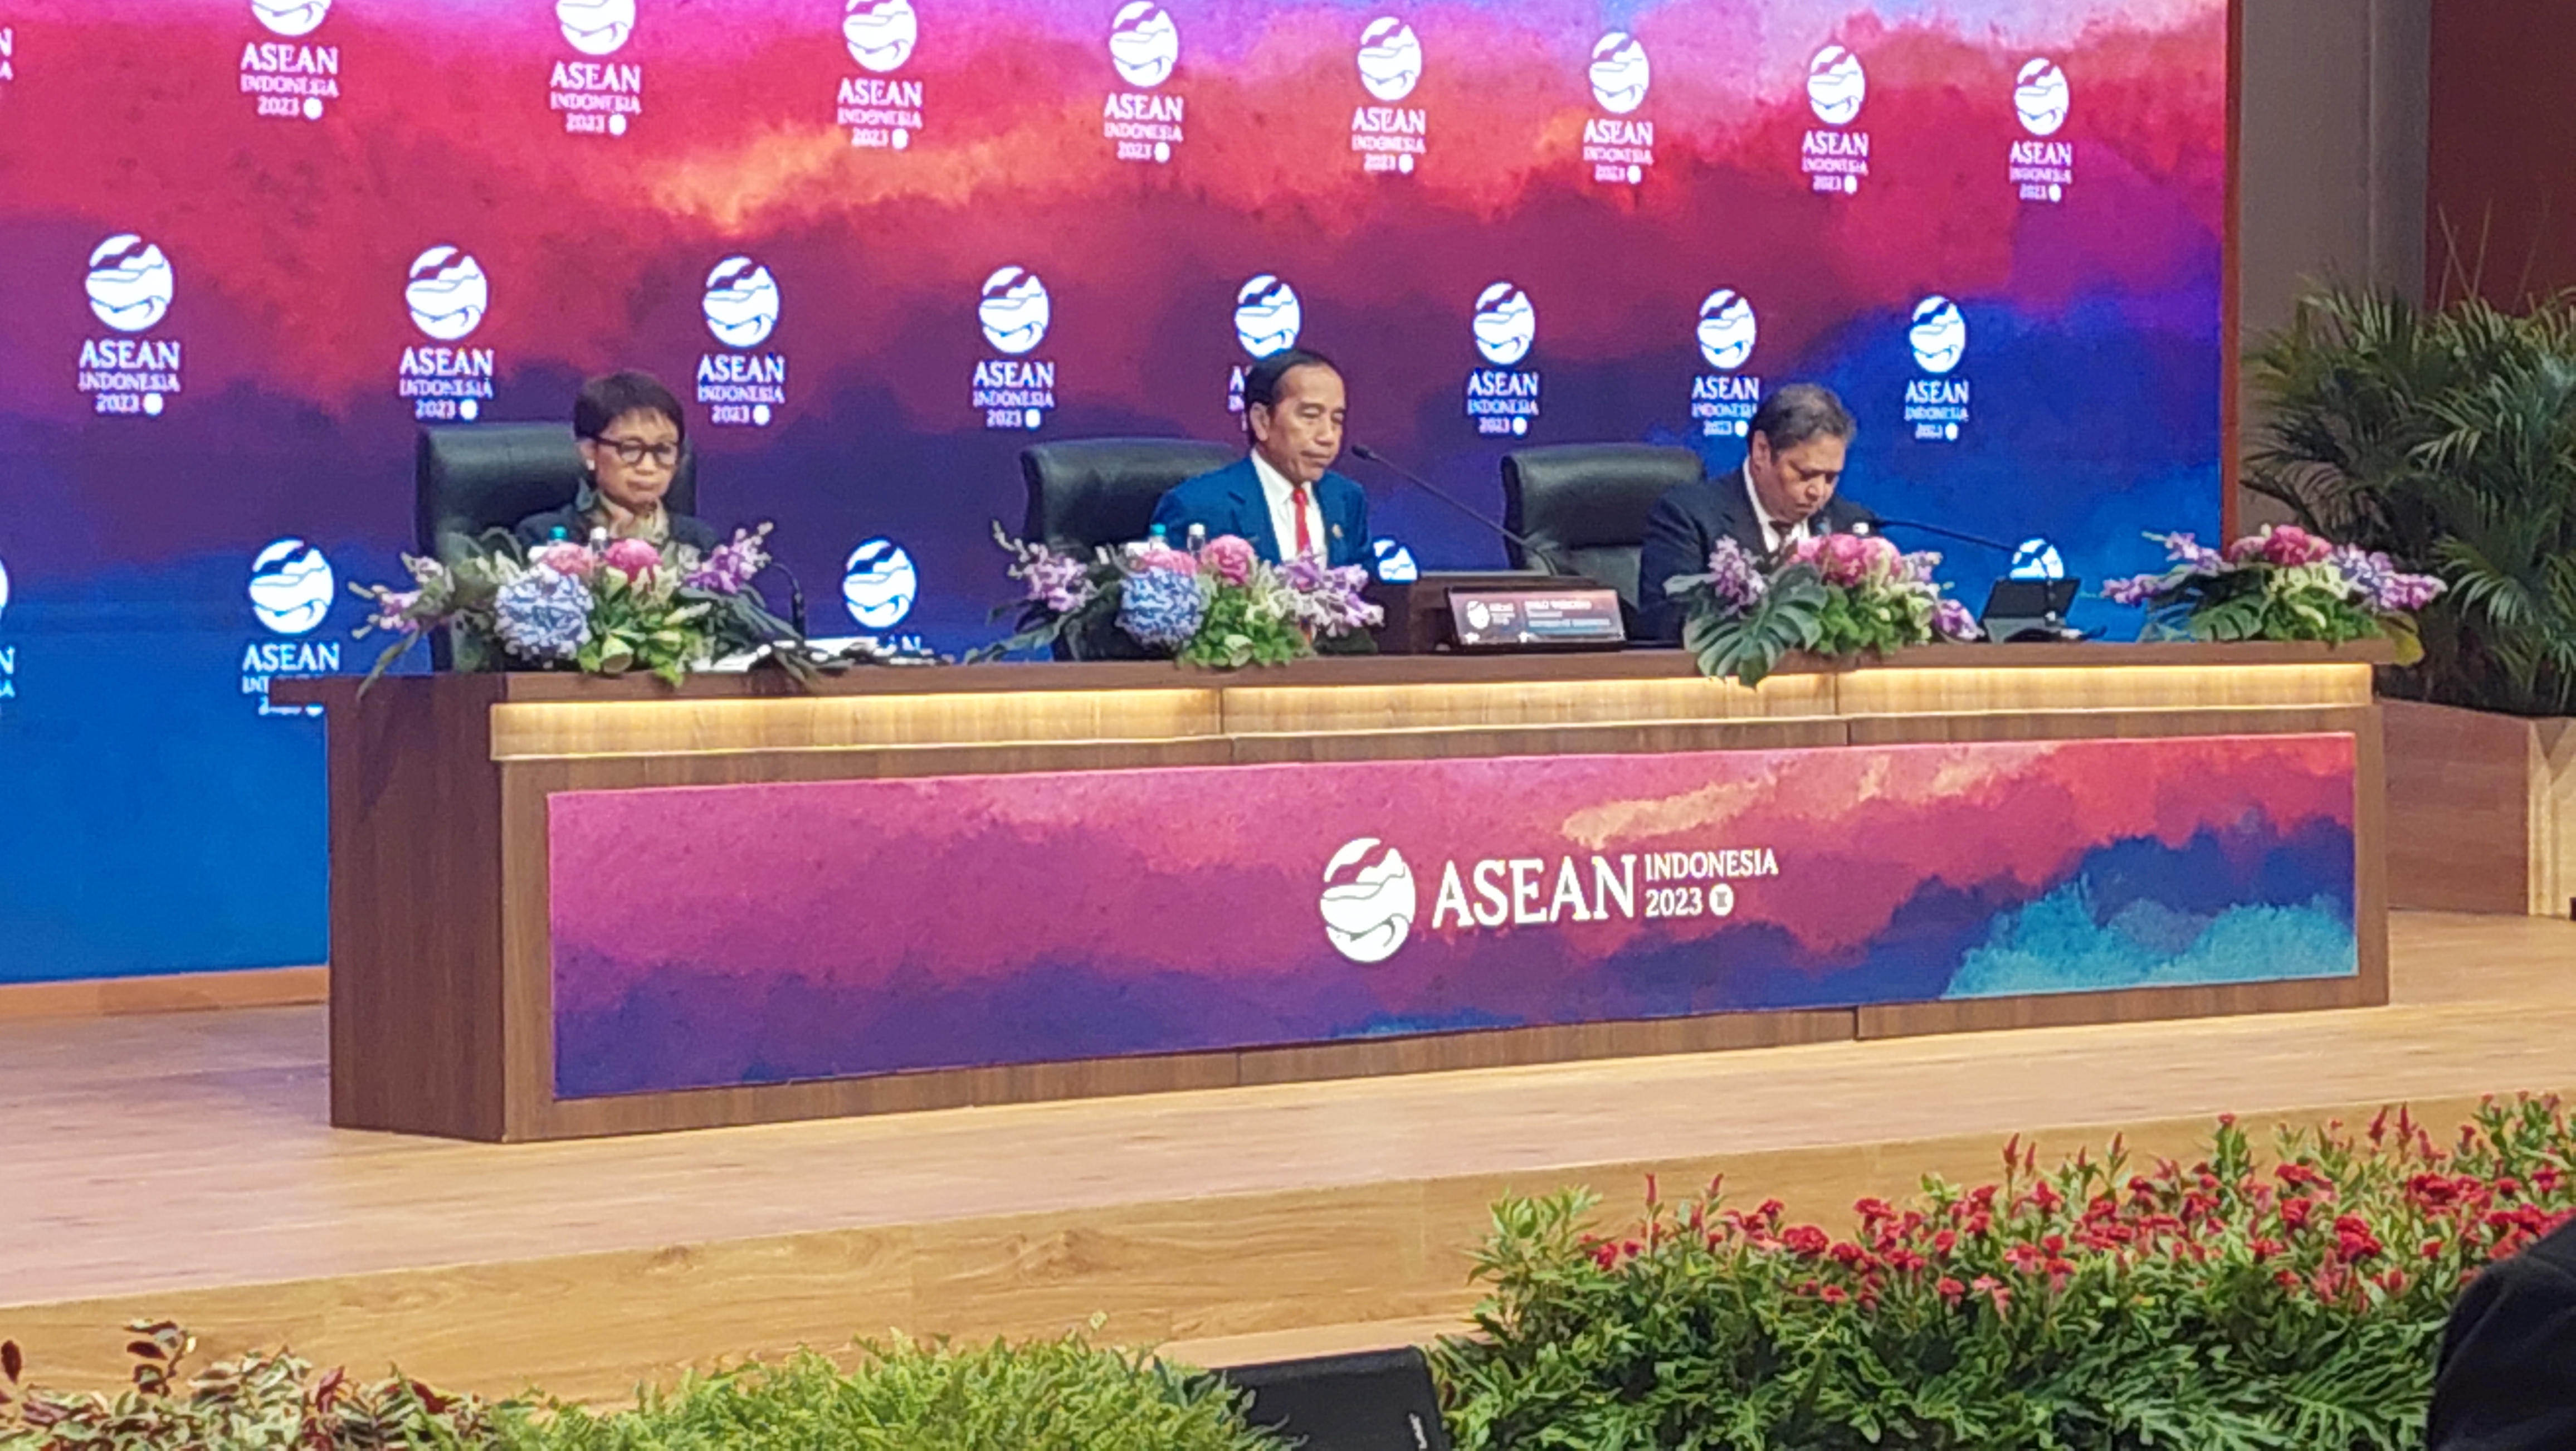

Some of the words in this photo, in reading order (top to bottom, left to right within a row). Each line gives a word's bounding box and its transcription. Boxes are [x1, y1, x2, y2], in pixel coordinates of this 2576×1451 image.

[241, 42, 338, 75] ASEAN
[549, 60, 641, 94] ASEAN
[837, 77, 923, 108] ASEAN
[1104, 92, 1184, 121] ASEAN
[1352, 106, 1426, 135] ASEAN
[1583, 118, 1653, 146] ASEAN
[1802, 130, 1869, 157] ASEAN
[2009, 140, 2072, 166] ASEAN
[79, 339, 180, 371] ASEAN
[399, 346, 494, 376] ASEAN
[697, 353, 785, 384] ASEAN
[78, 371, 180, 392] INDONESIA
[973, 361, 1055, 388] ASEAN
[1467, 370, 1539, 396] ASEAN
[1691, 375, 1759, 401] ASEAN
[1905, 379, 1969, 404] ASEAN
[242, 642, 339, 672] ASEAN
[1645, 848, 1779, 880] INDONESIA
[1432, 854, 1637, 929] ASEAN
[1645, 888, 1704, 918] 2023
